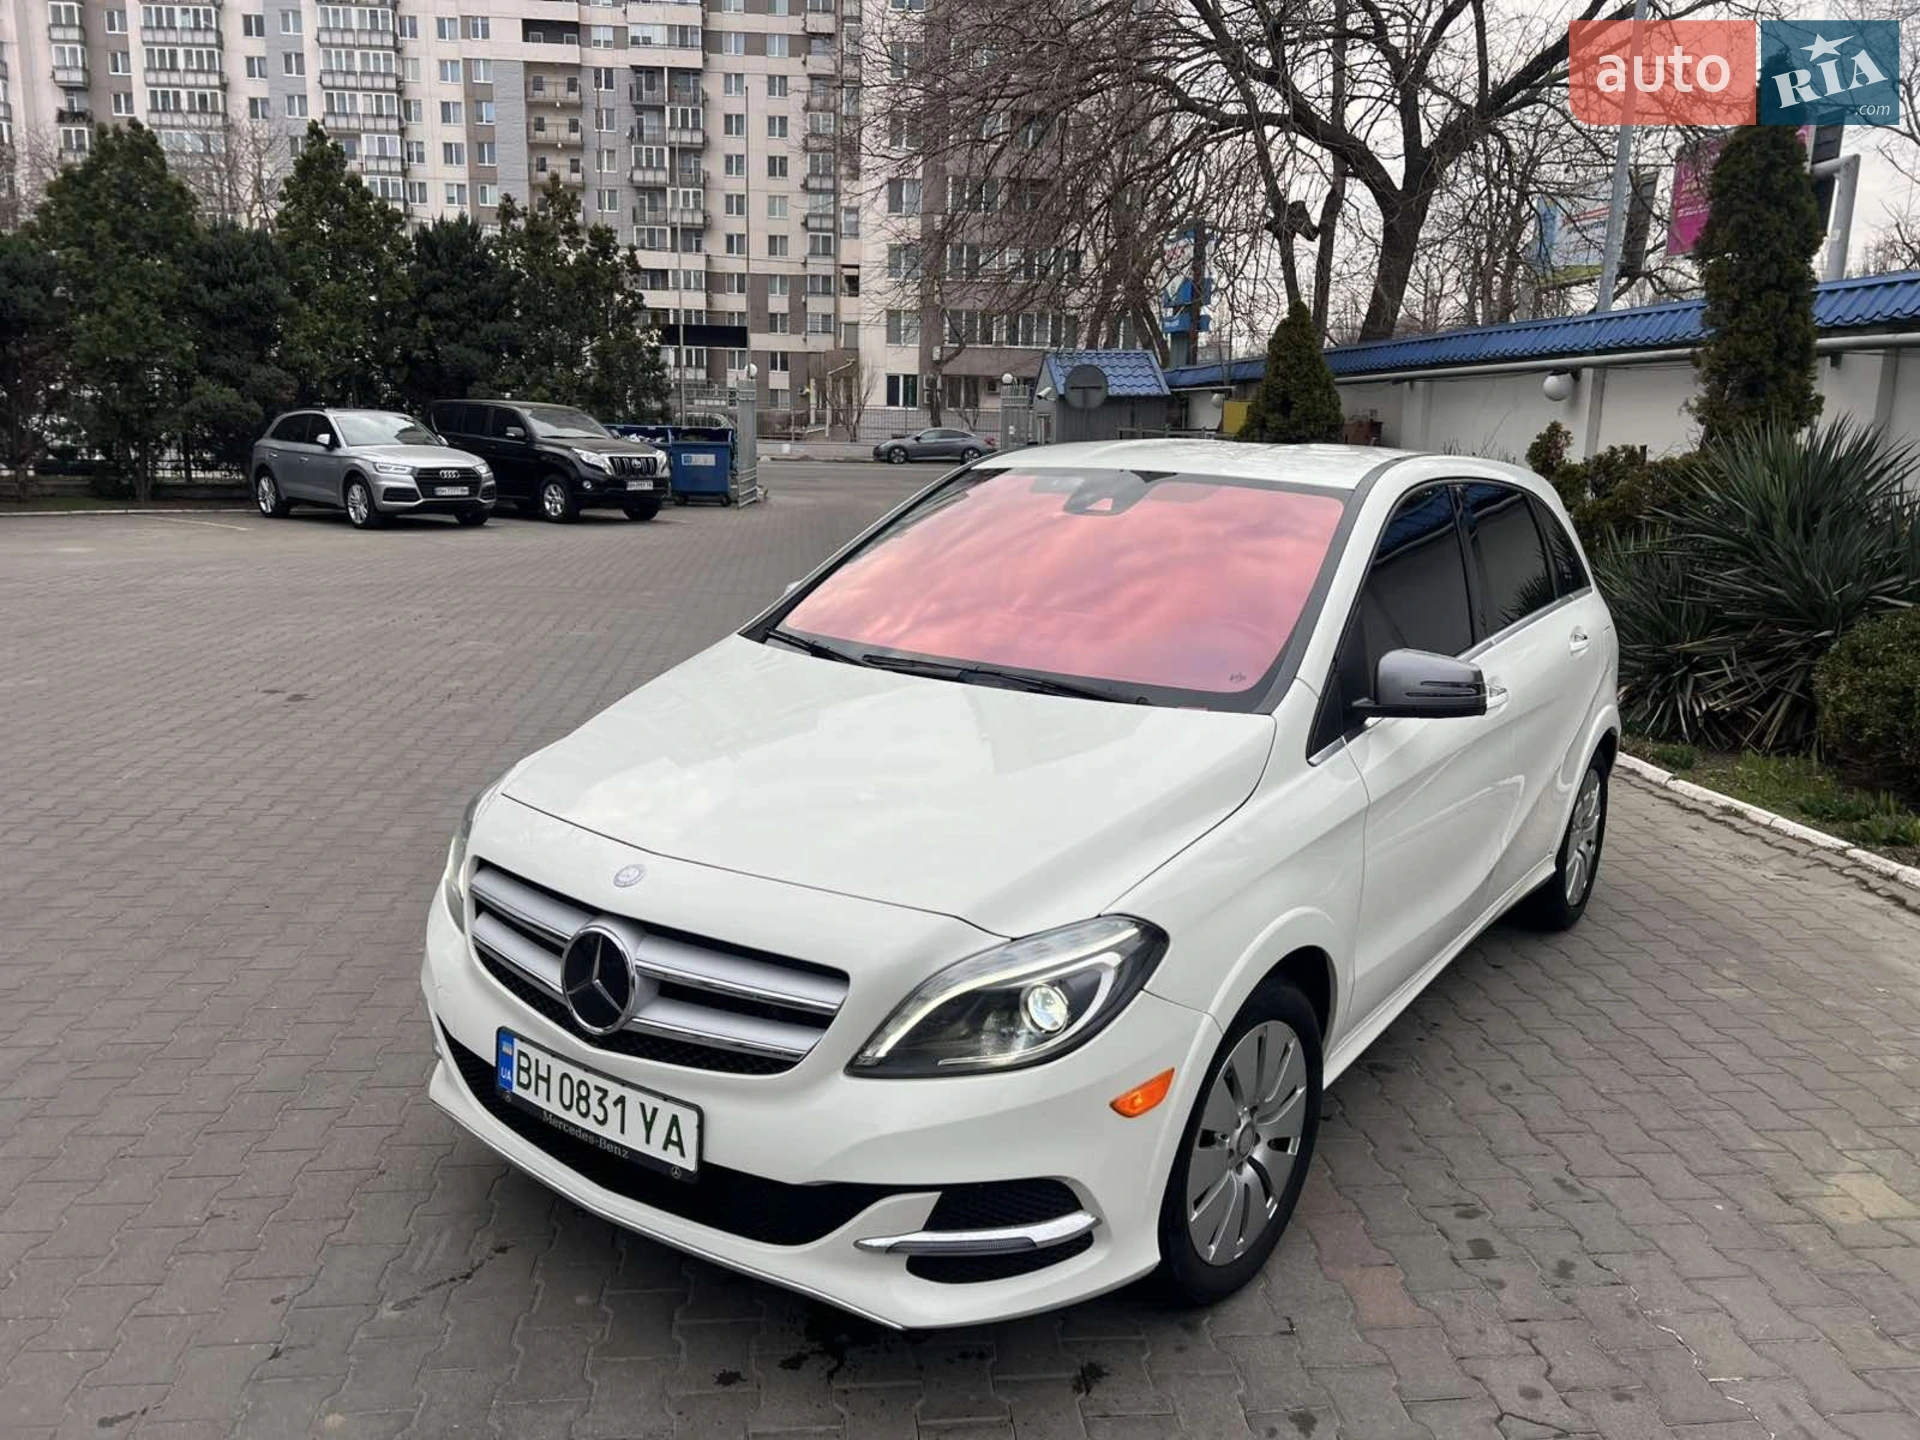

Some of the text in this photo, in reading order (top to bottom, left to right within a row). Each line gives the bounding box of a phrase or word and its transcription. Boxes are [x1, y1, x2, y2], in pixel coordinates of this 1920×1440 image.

[501, 1066, 512, 1081] UA
[517, 1050, 686, 1158] BH 0831 YA
[542, 1111, 630, 1159] Mercedes-Benz
